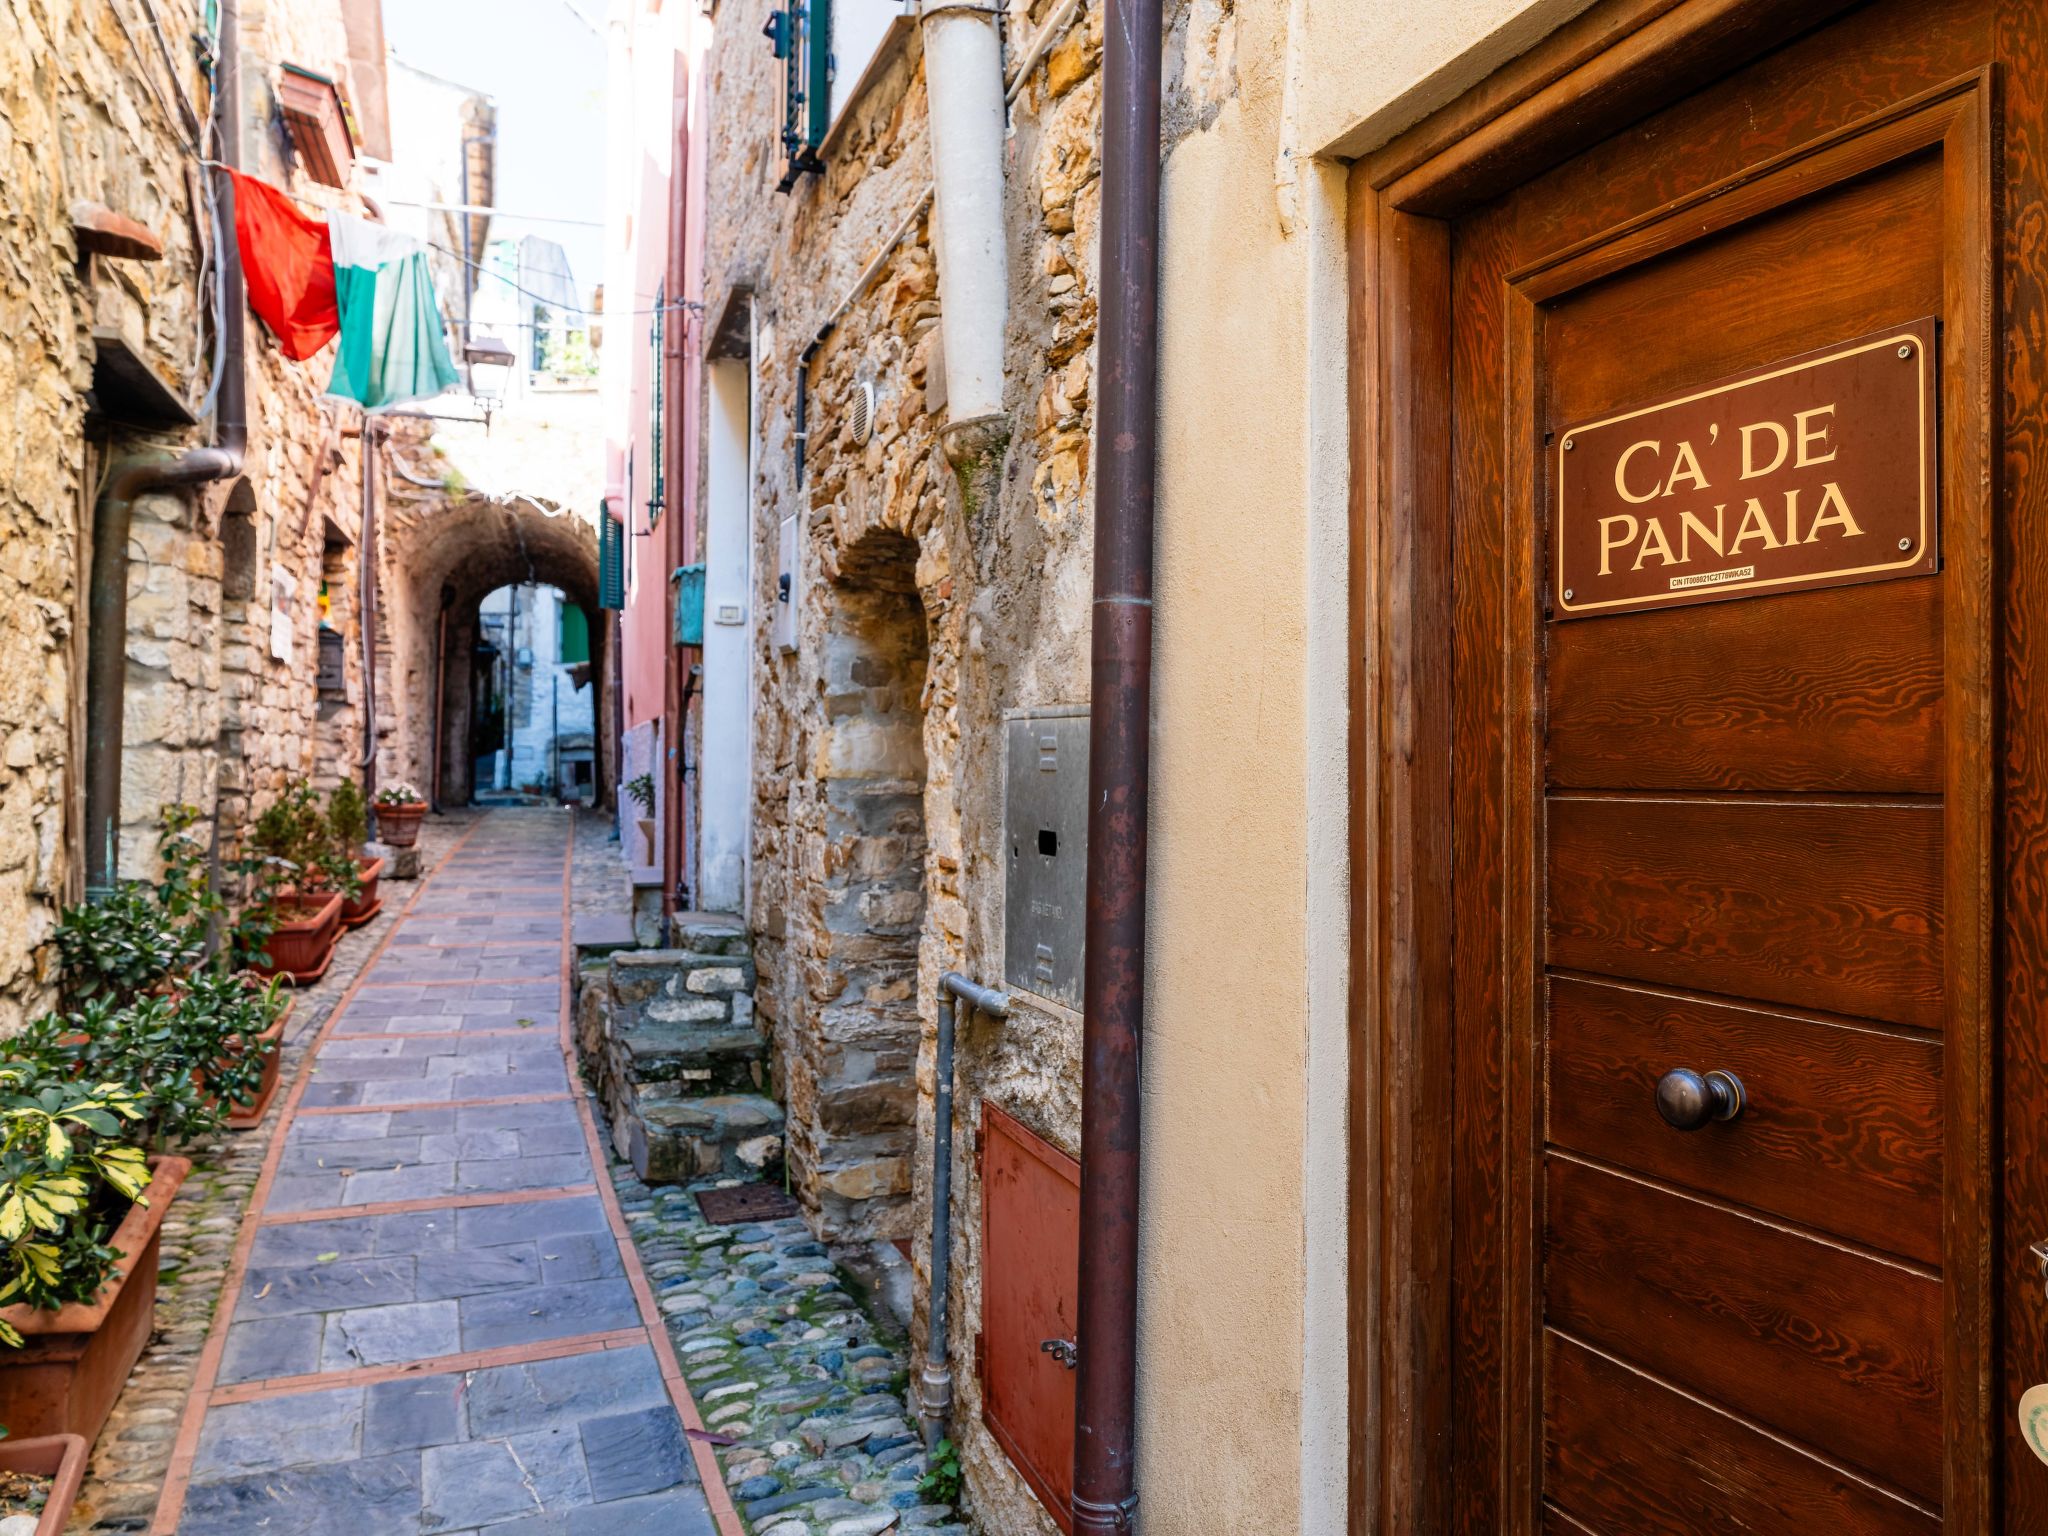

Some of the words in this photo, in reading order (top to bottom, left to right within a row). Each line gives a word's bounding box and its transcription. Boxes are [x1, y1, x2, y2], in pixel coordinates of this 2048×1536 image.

[1614, 423, 1719, 504] CA'
[1739, 403, 1838, 480] DE
[1597, 482, 1865, 576] PANAIA
[1672, 578, 1683, 587] CIN
